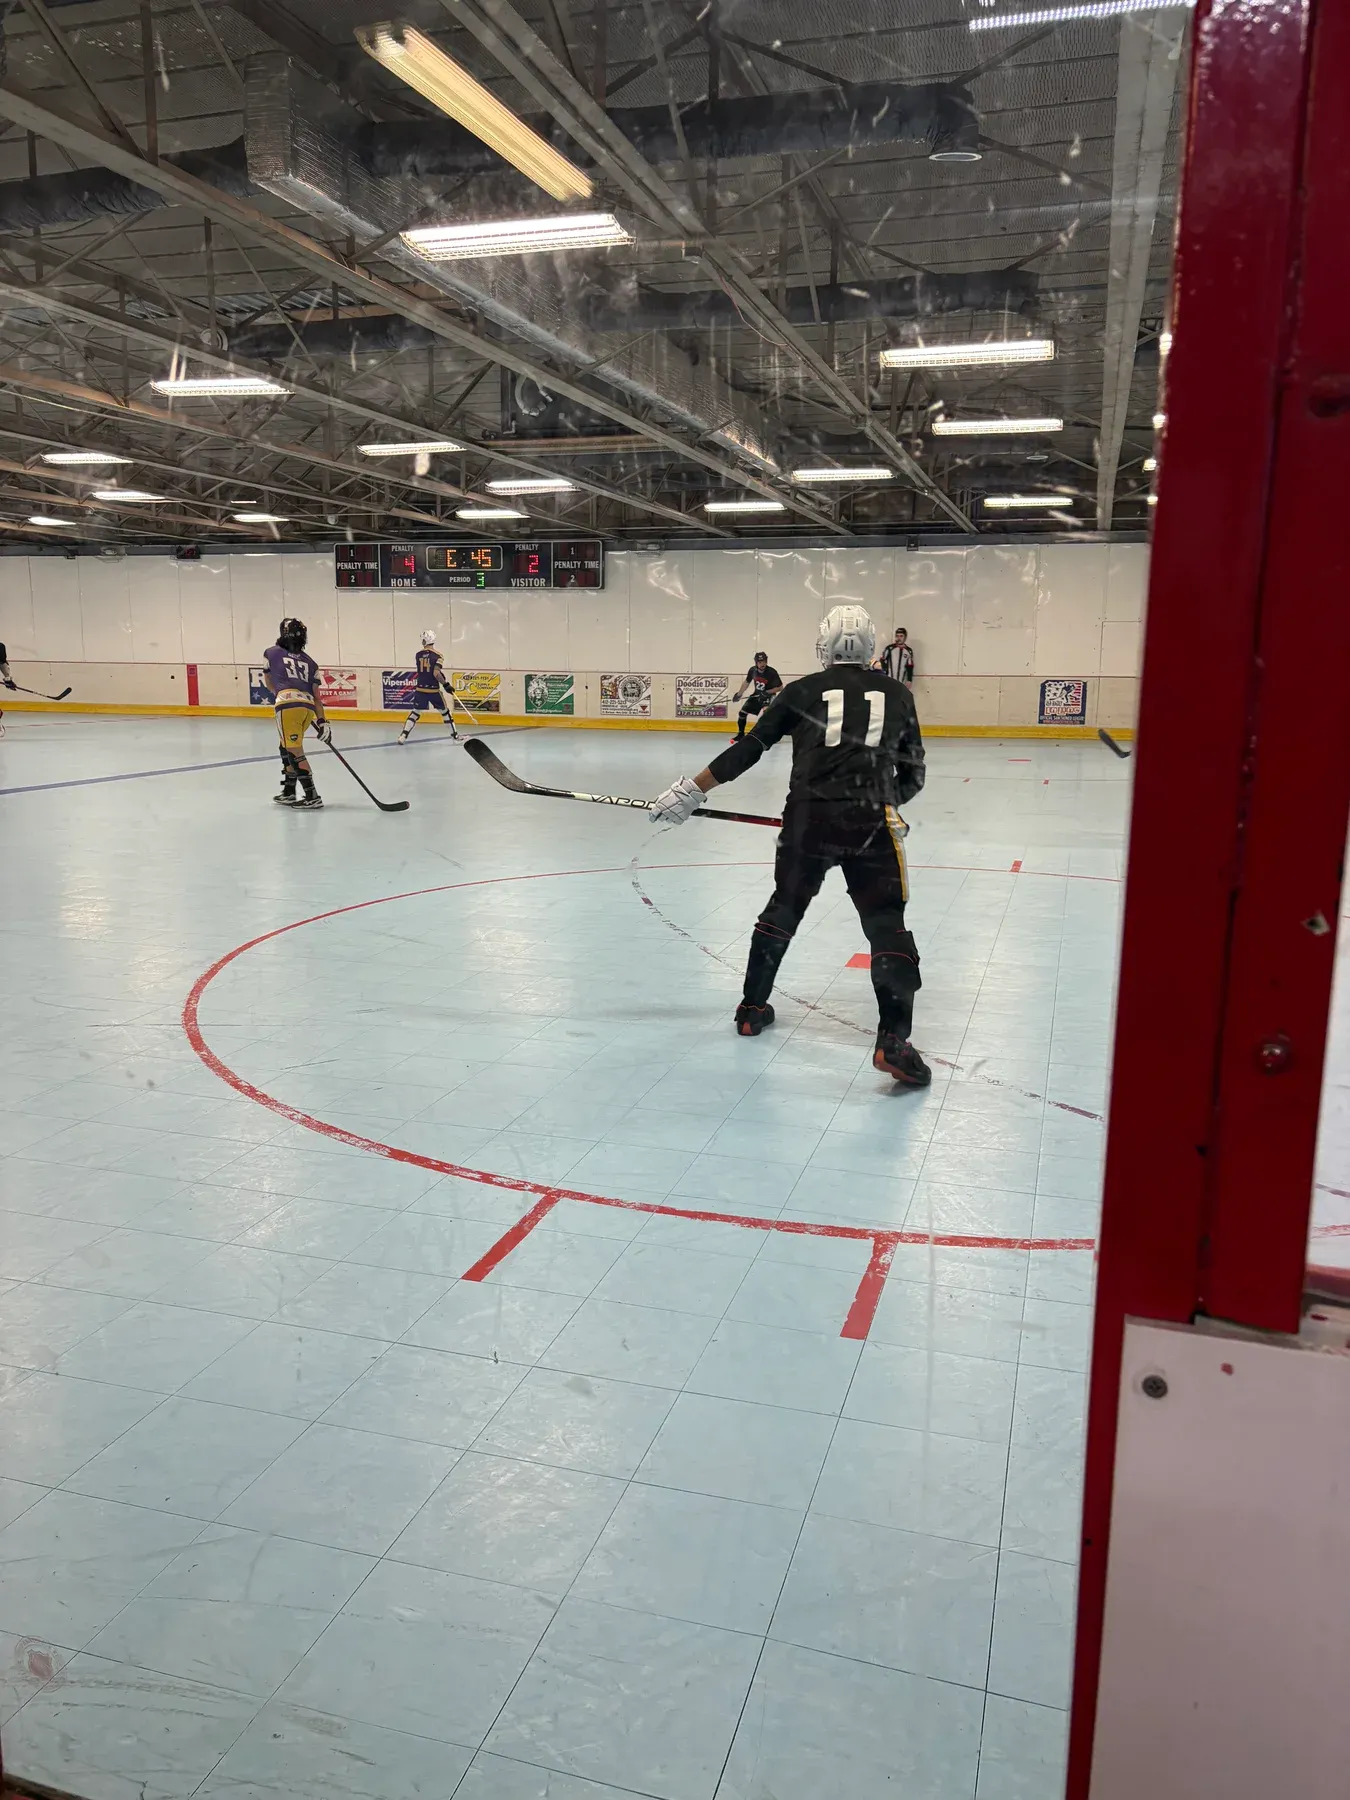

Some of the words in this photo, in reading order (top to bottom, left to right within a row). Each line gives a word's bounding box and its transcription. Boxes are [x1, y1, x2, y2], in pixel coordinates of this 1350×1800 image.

[350, 549, 355, 557] 1
[570, 547, 575, 555] 1
[337, 562, 362, 570] PENALTY
[364, 562, 379, 570] TIME
[404, 555, 415, 573] 4
[529, 555, 539, 573] 2
[554, 561, 582, 569] PENALTY
[584, 561, 600, 569] TIME
[391, 578, 417, 587] HOME
[511, 578, 546, 587] VISITOR
[570, 575, 575, 583] 2
[282, 657, 310, 683] 33
[678, 679, 704, 688] Doodie
[705, 680, 727, 688] Deeds
[755, 681, 766, 691] 22
[822, 689, 885, 747] 11
